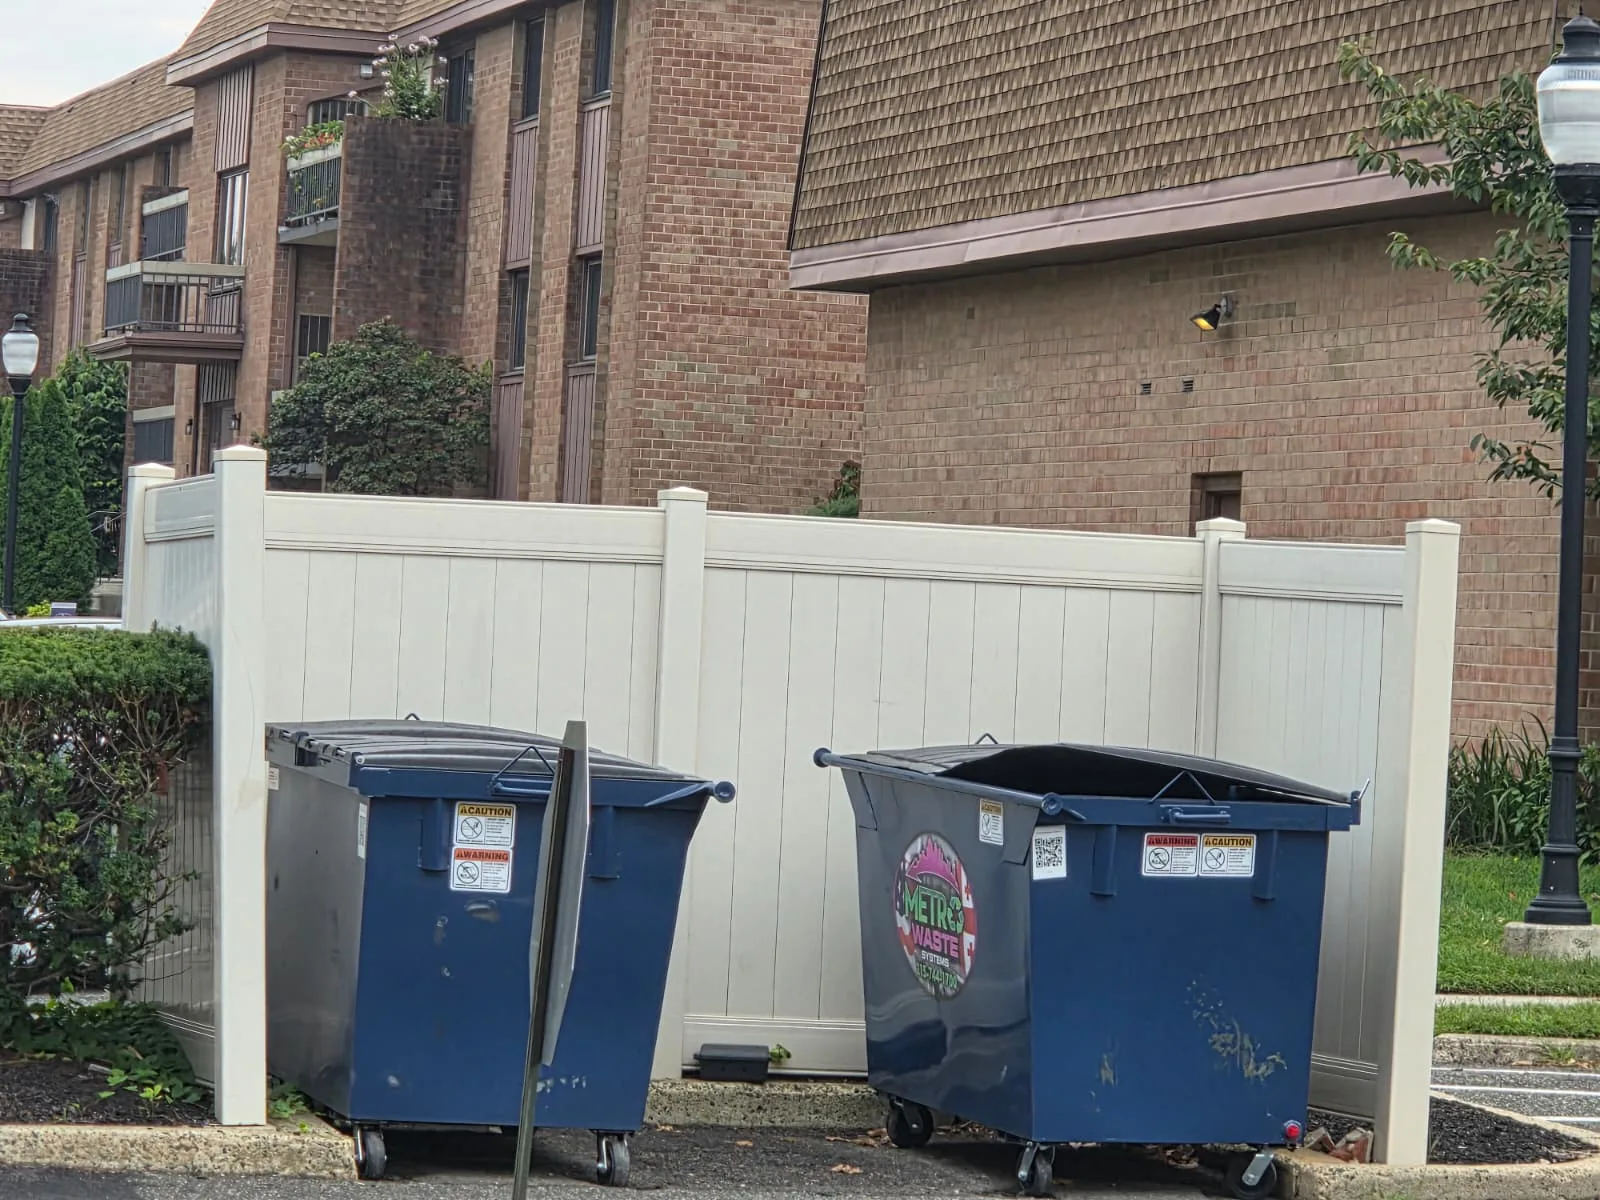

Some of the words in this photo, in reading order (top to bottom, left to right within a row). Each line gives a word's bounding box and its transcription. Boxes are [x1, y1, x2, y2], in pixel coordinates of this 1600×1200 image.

[467, 806, 512, 816] CAUTION
[1154, 837, 1196, 845] WARNING
[1211, 838, 1252, 846] CAUTION
[463, 851, 508, 861] WARNING
[904, 881, 964, 934] METRO
[912, 922, 959, 958] WASTE
[921, 950, 949, 968] SYSTEMS
